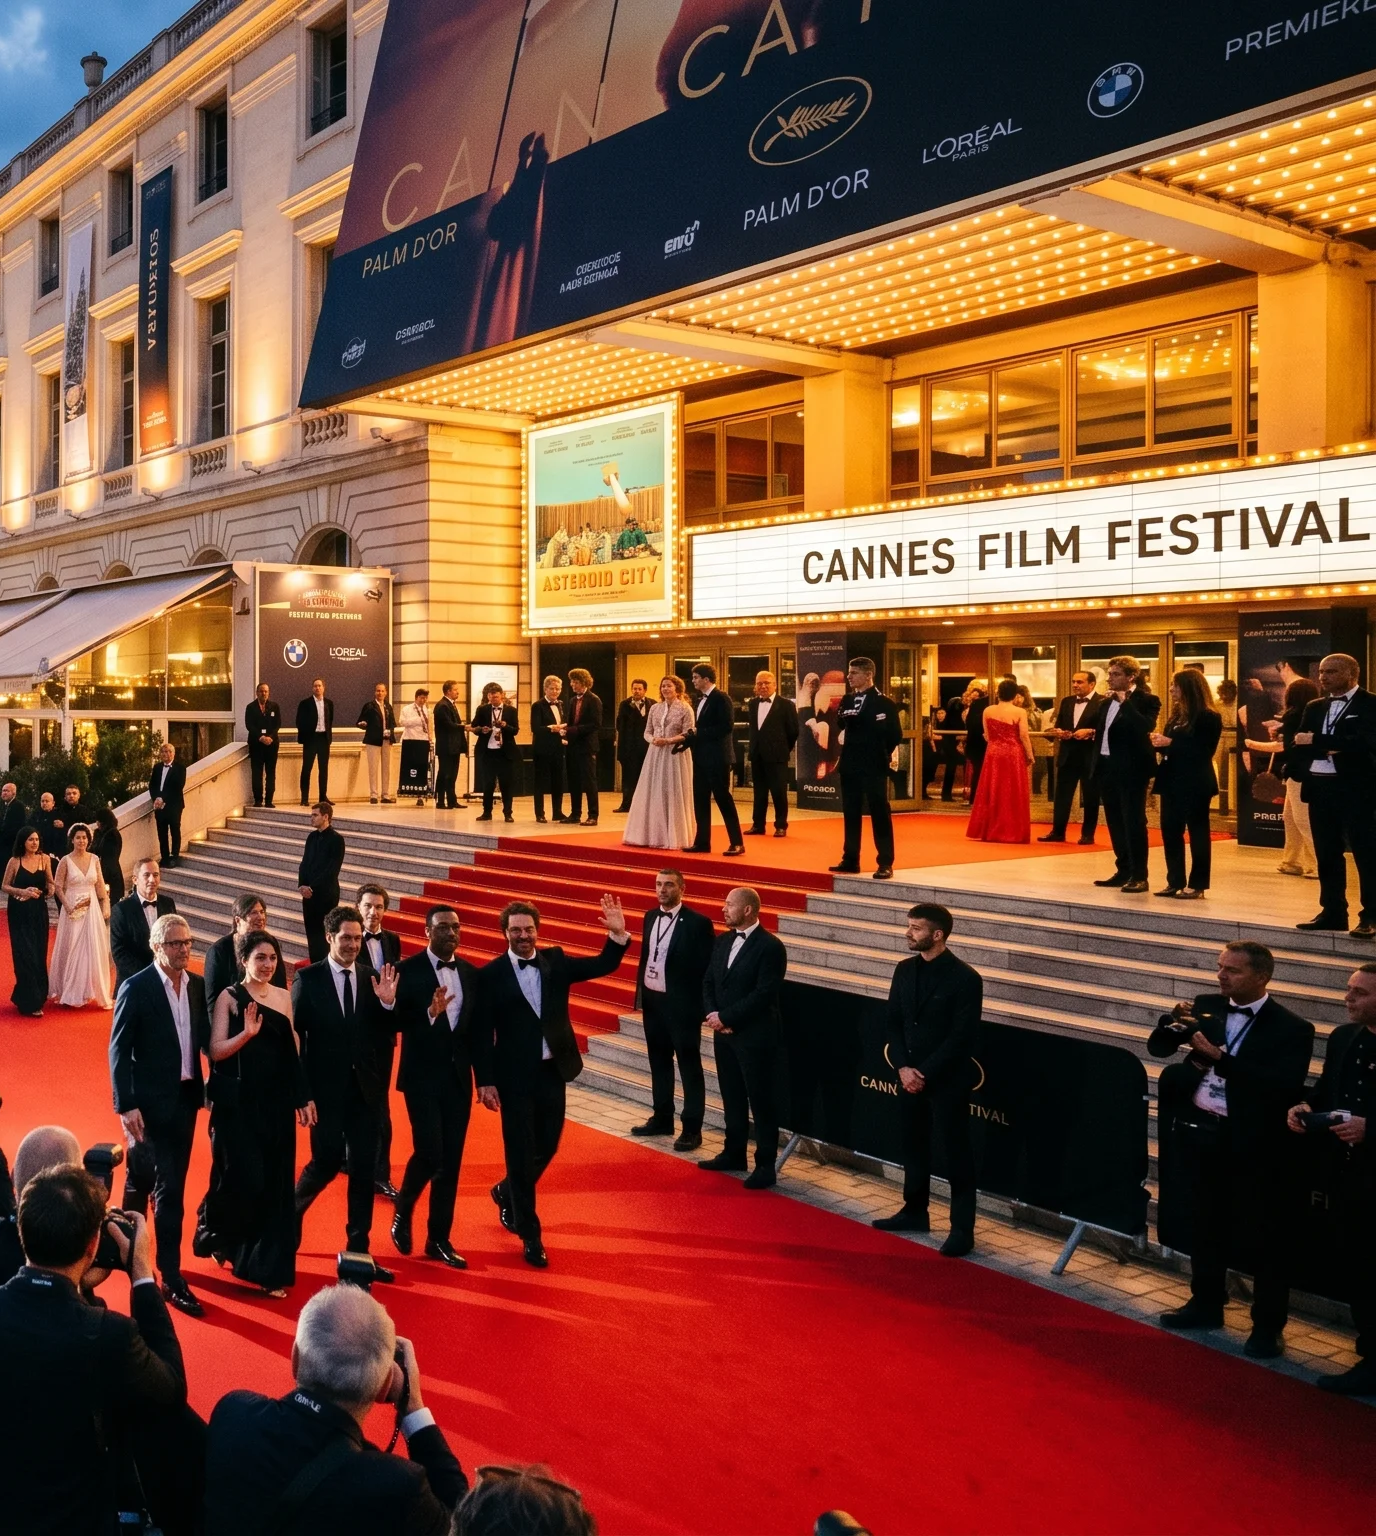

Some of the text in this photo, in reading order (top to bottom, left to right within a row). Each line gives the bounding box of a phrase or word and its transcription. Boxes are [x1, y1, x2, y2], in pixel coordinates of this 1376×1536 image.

[923, 118, 1022, 164] L'ORÉAL
[952, 144, 989, 162] PARIS
[743, 168, 870, 231] PALM D'OR
[362, 222, 458, 279] PALM D'OR
[803, 497, 1371, 585] CANNES FILM FESTIVAL
[542, 565, 658, 592] ASTEROID CITY
